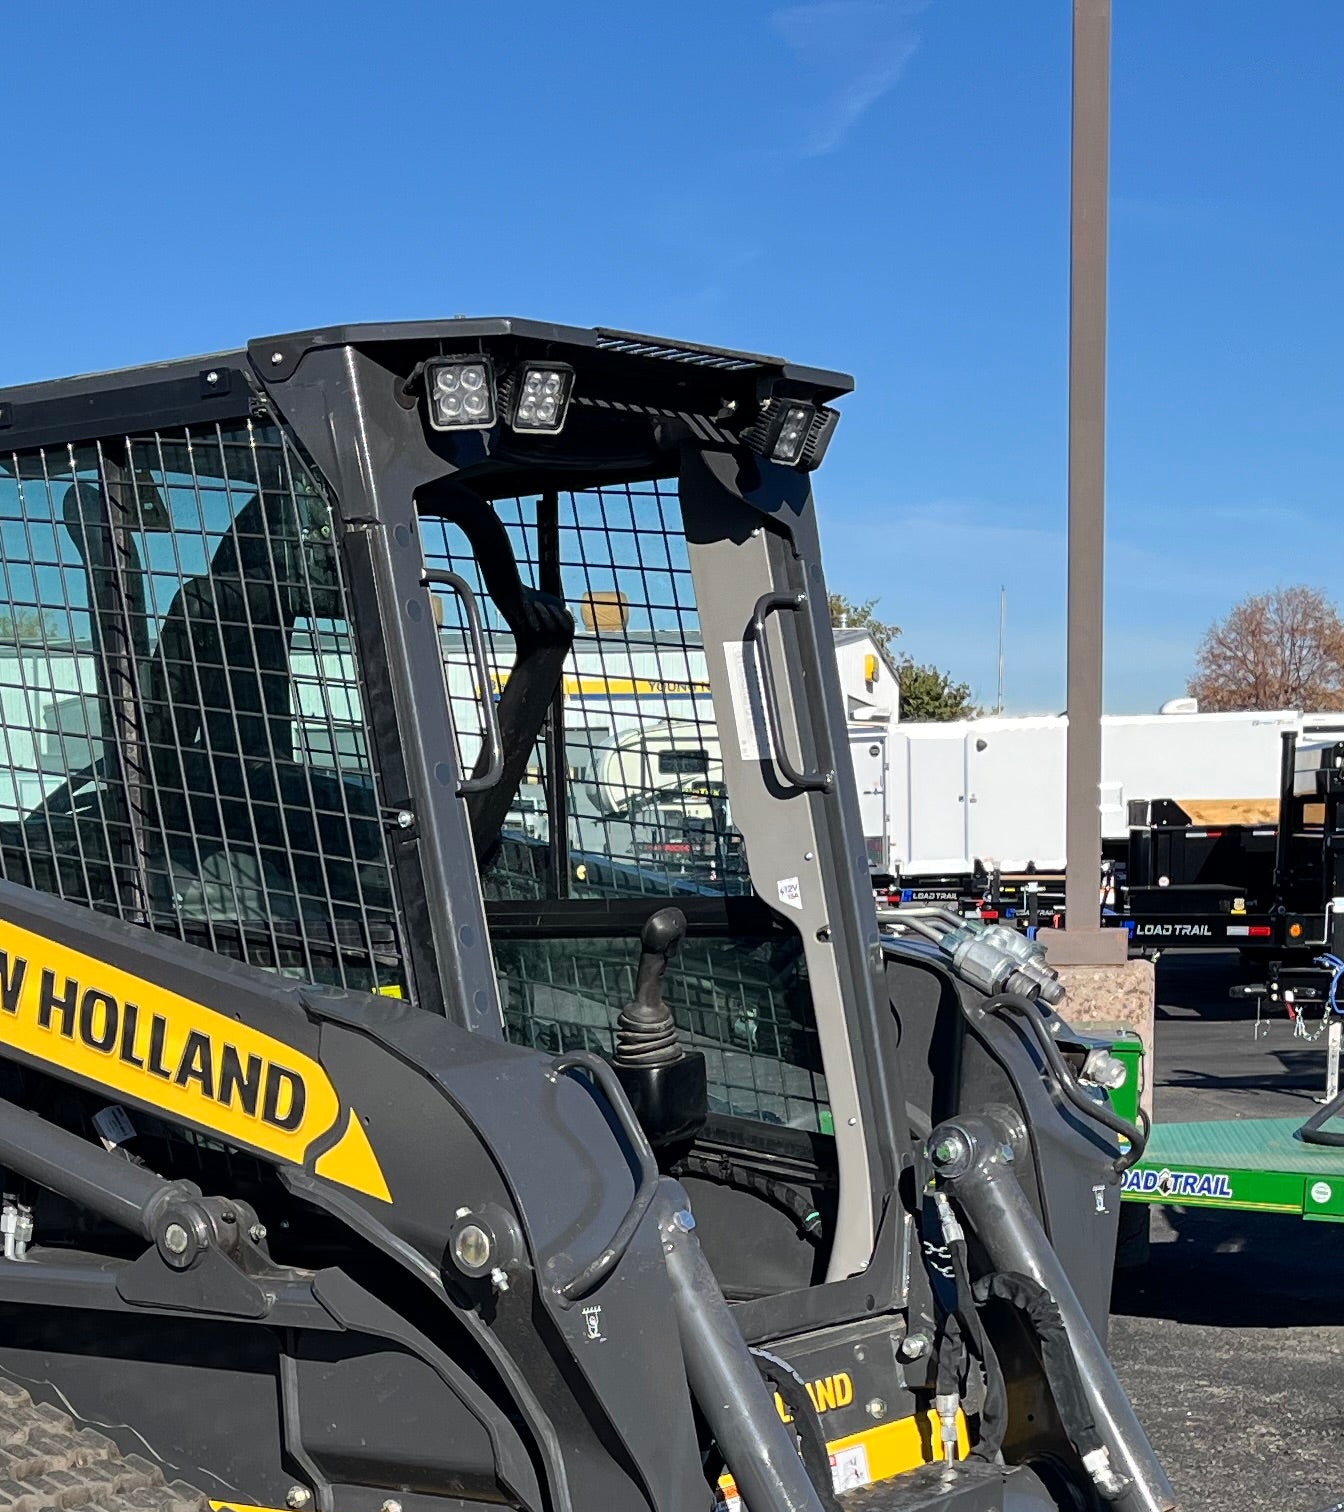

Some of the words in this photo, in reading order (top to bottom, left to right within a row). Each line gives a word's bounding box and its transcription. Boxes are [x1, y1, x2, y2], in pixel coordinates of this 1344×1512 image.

[913, 892, 935, 900] LOAD
[936, 892, 957, 900] TRAIL
[1136, 924, 1173, 936] LOAD
[1174, 924, 1212, 936] TRAIL
[37, 967, 306, 1131] HOLLAND
[1170, 1172, 1232, 1197] TRAIL
